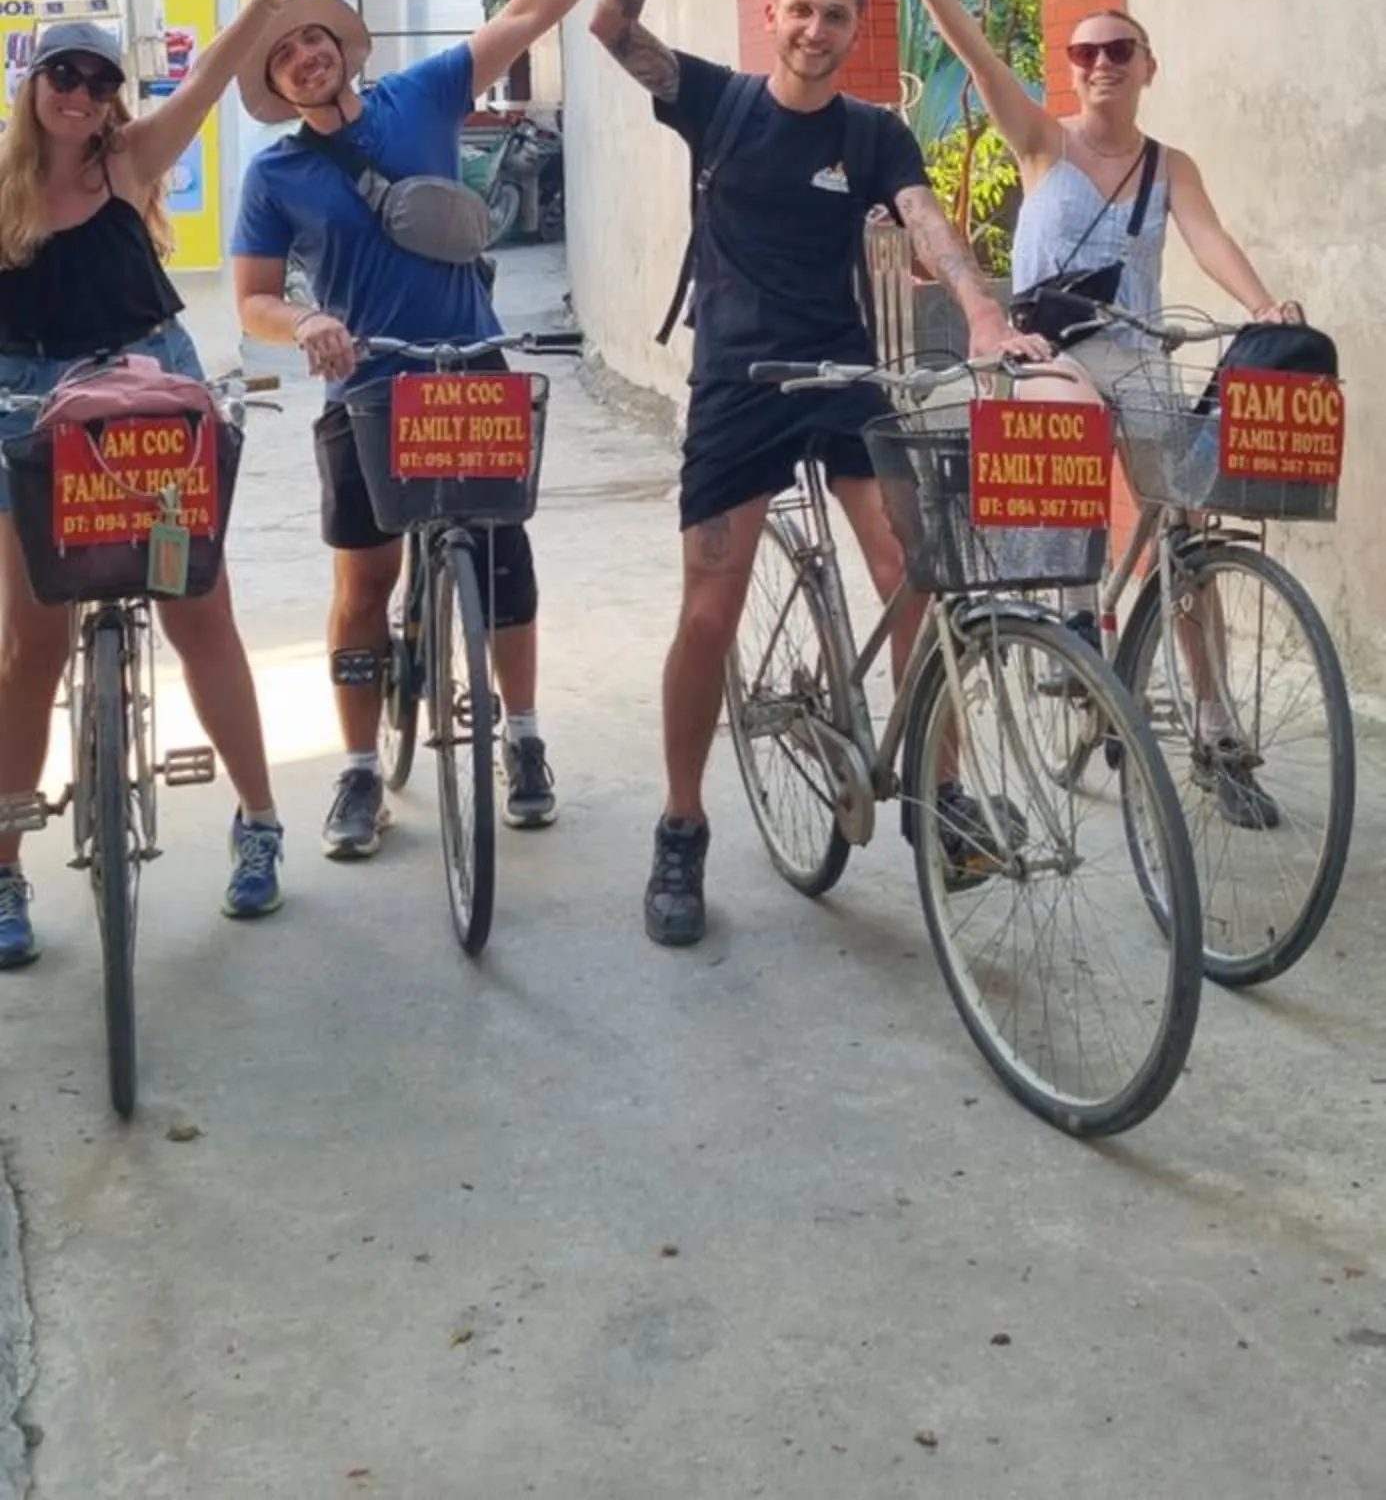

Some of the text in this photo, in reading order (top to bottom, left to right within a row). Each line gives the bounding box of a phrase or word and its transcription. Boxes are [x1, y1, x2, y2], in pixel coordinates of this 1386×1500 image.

[420, 382, 462, 405] TAM
[1227, 382, 1285, 423] TAM
[399, 416, 525, 442] FAMILY HOTEL
[1001, 410, 1044, 439] TAM
[99, 428, 185, 458] AM COC
[1228, 427, 1337, 456] FAMILY HOTEL
[978, 452, 1107, 486] FAMILY HOTEL
[62, 468, 140, 504] FAMILY
[177, 506, 210, 526] 874
